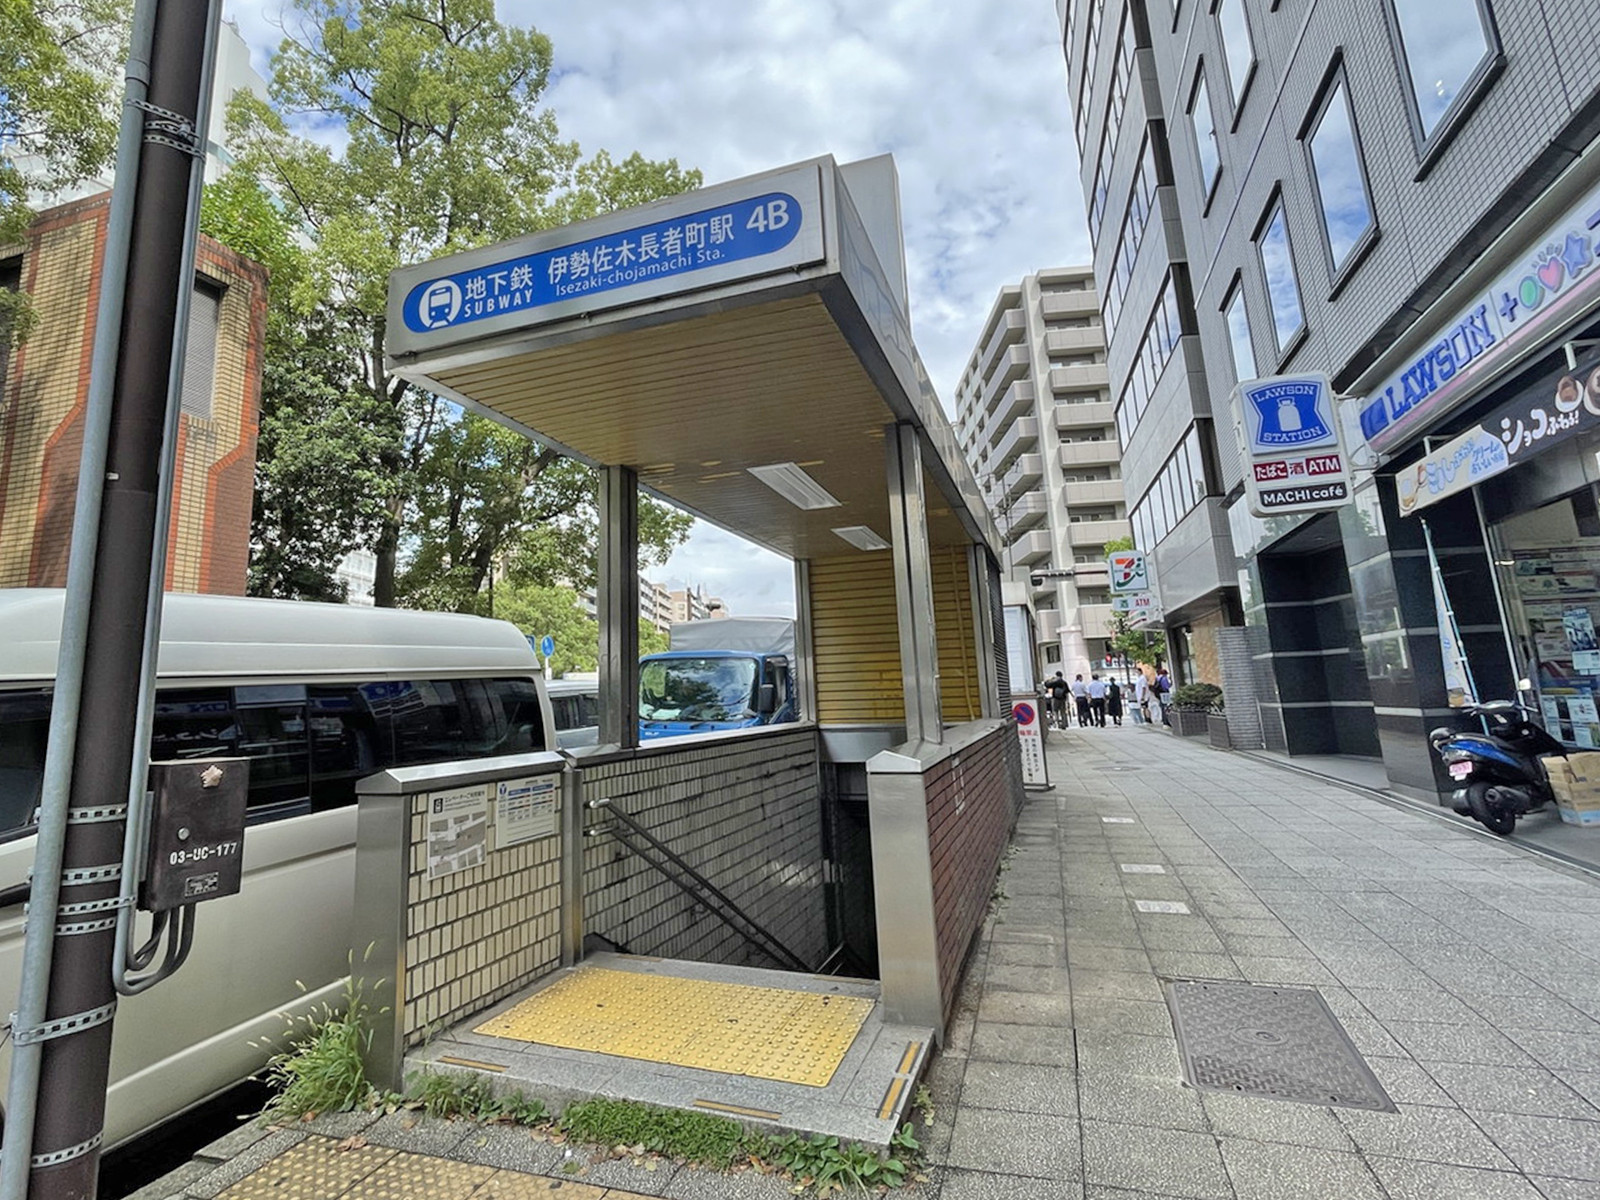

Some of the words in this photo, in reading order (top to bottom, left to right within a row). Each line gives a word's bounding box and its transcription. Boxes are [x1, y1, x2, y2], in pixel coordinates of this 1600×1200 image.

[465, 265, 533, 301] 地下鉄
[548, 213, 735, 285] 伊勢佐木長者町駅
[746, 199, 790, 234] 4B
[464, 289, 533, 318] SUBWAY
[556, 253, 692, 297] Isezaki-chojamachi
[697, 248, 725, 264] Sta.
[1386, 304, 1496, 420] LAWSON
[1254, 385, 1314, 402] LAWSON
[1263, 427, 1321, 442] STATION
[1256, 462, 1288, 480] たばこ
[1309, 457, 1339, 472] ATM
[1264, 490, 1310, 504] MACHI
[1312, 485, 1343, 499] café
[1135, 598, 1151, 607] ATM
[169, 842, 238, 865] 03-UC-177
